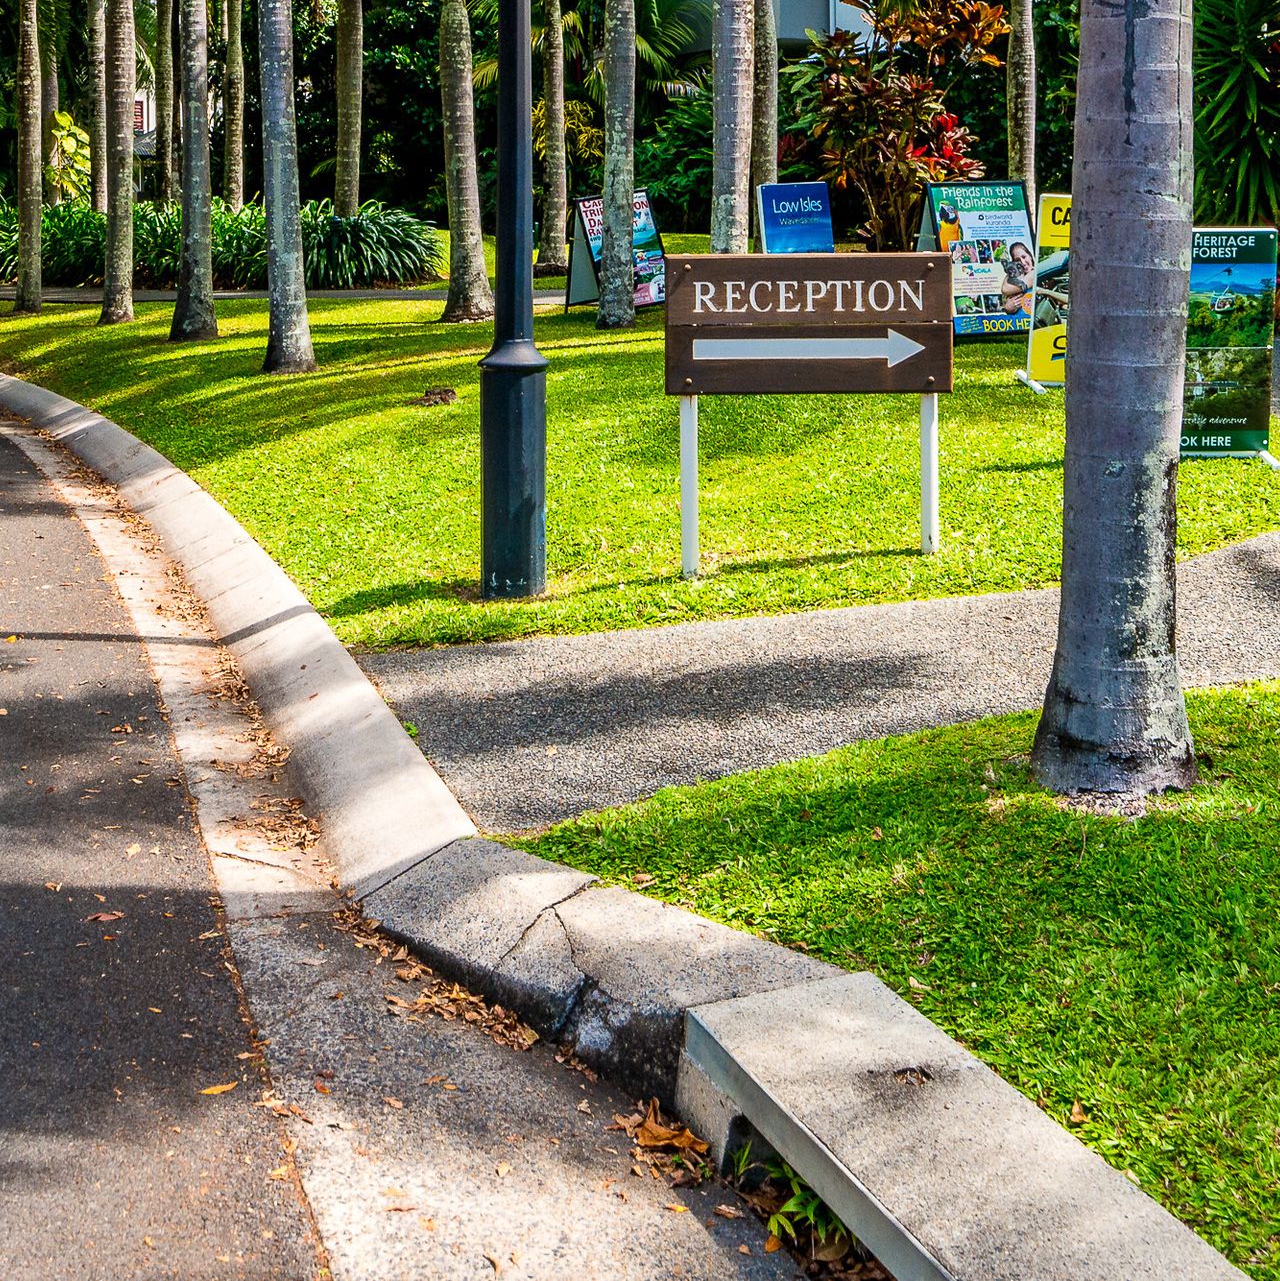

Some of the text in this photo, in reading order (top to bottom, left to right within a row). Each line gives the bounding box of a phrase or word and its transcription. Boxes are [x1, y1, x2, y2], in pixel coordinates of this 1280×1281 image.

[941, 186, 1013, 198] Friends in the
[772, 196, 823, 214] Low Isles
[955, 197, 1013, 209] Rainforest
[1194, 236, 1255, 246] HERITAGE
[1193, 247, 1238, 258] FOREST
[692, 279, 926, 313] RECEPTION
[982, 318, 1014, 333] BOOK
[1209, 415, 1248, 424] adventure
[1202, 436, 1232, 447] HERE
